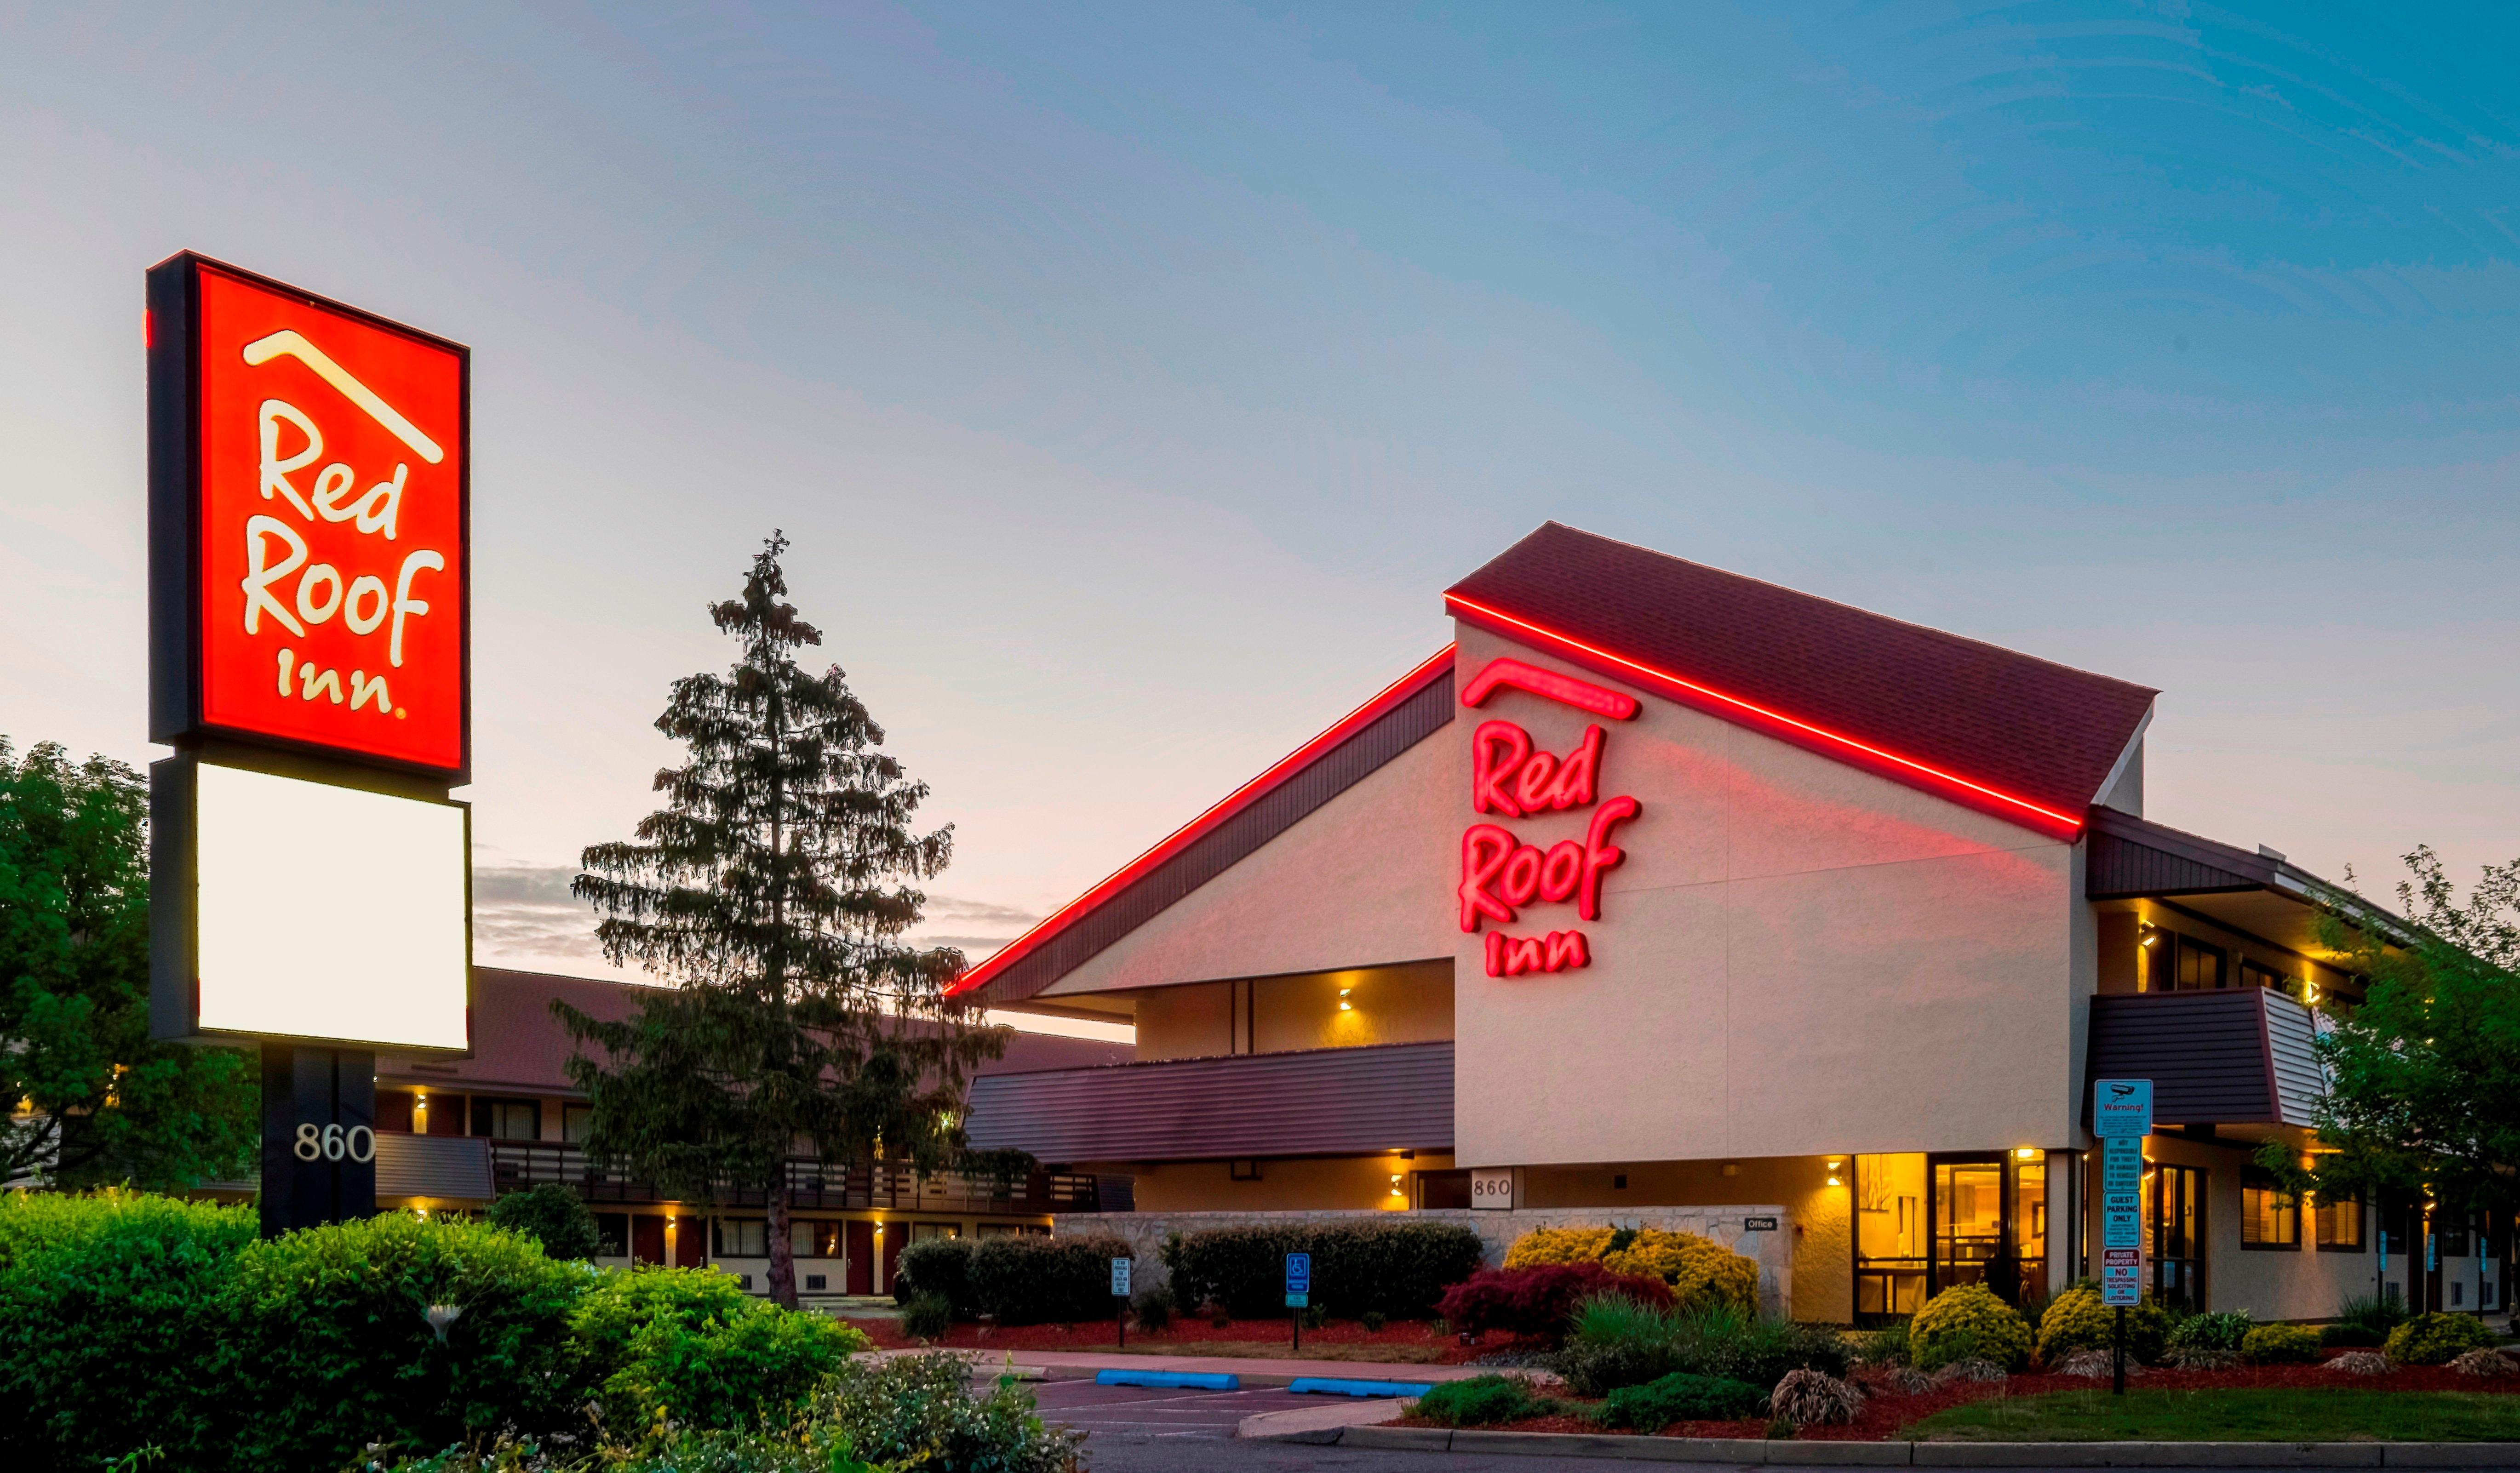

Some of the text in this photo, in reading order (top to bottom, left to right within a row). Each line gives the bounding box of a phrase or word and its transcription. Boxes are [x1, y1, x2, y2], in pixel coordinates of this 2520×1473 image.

[258, 399, 408, 540] Red
[242, 514, 444, 668] Roof
[1473, 720, 1603, 818] Red
[1459, 796, 1640, 932] Roof
[1486, 930, 1589, 977] Inn
[2104, 1104, 2143, 1113] Warning!
[294, 1123, 376, 1164] 860
[1474, 1180, 1510, 1195] 860
[1748, 1220, 1773, 1228] Office
